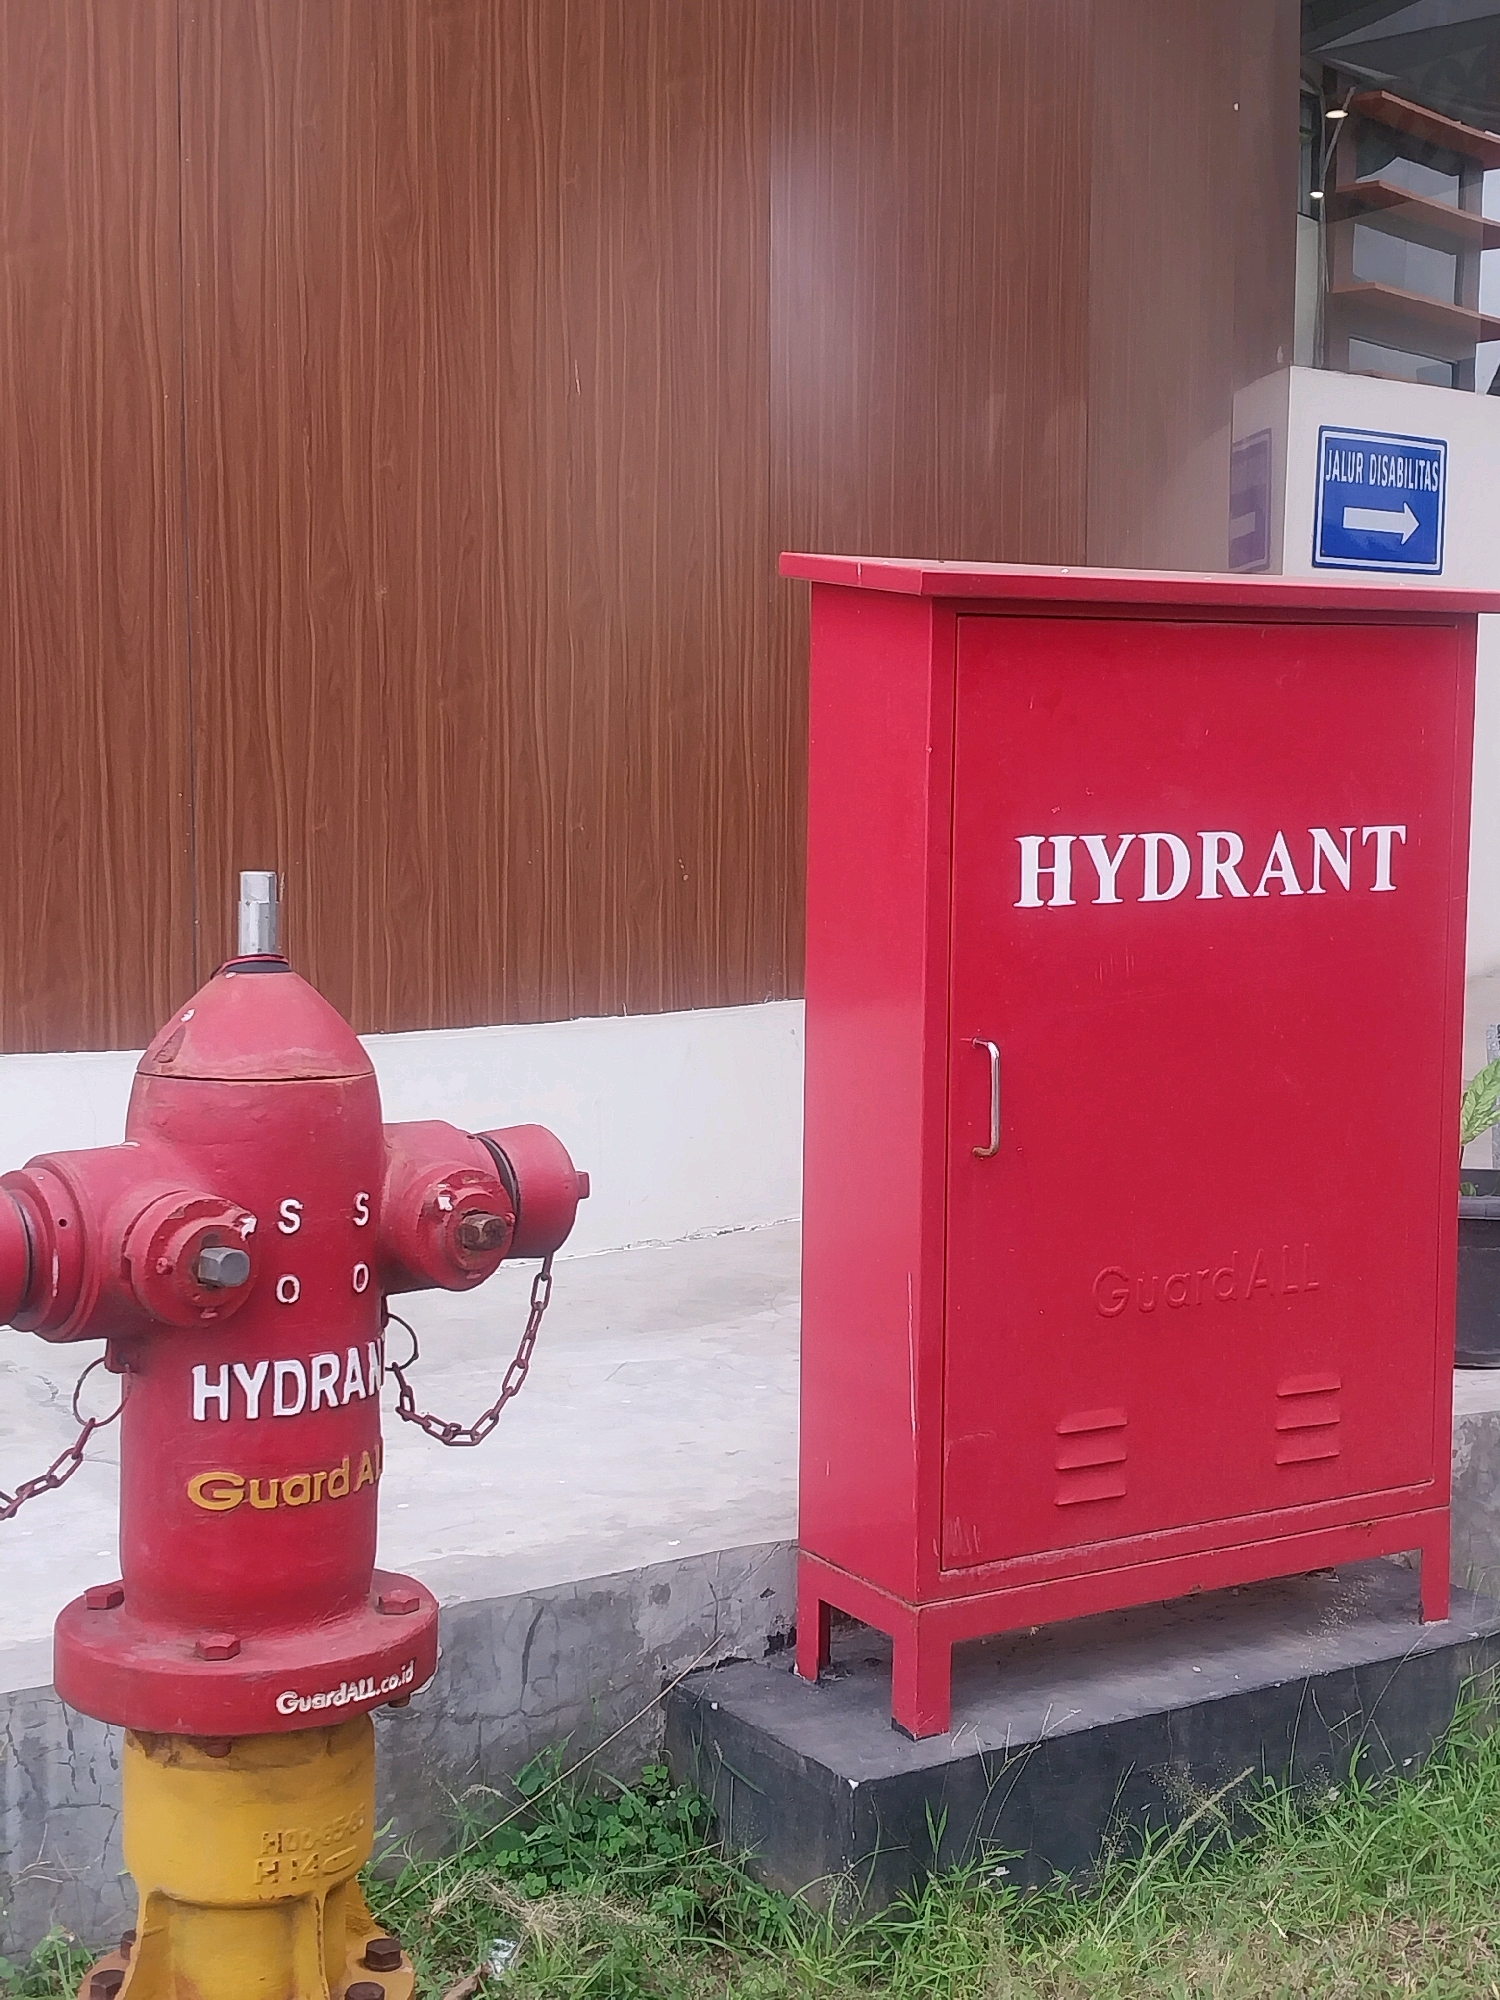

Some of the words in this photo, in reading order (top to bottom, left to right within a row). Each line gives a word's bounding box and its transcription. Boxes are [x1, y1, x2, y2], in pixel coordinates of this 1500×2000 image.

[1325, 449, 1364, 484] JALUR
[1369, 453, 1440, 492] DISABILITAS
[1012, 825, 1407, 908] HYDRANT
[277, 1198, 303, 1234] S
[351, 1191, 371, 1227] S
[1092, 1242, 1320, 1319] GuardALL
[191, 1331, 386, 1422] HYDRAN
[187, 1444, 383, 1512] GuardAL
[275, 1659, 415, 1715] GuardALL.co.id
